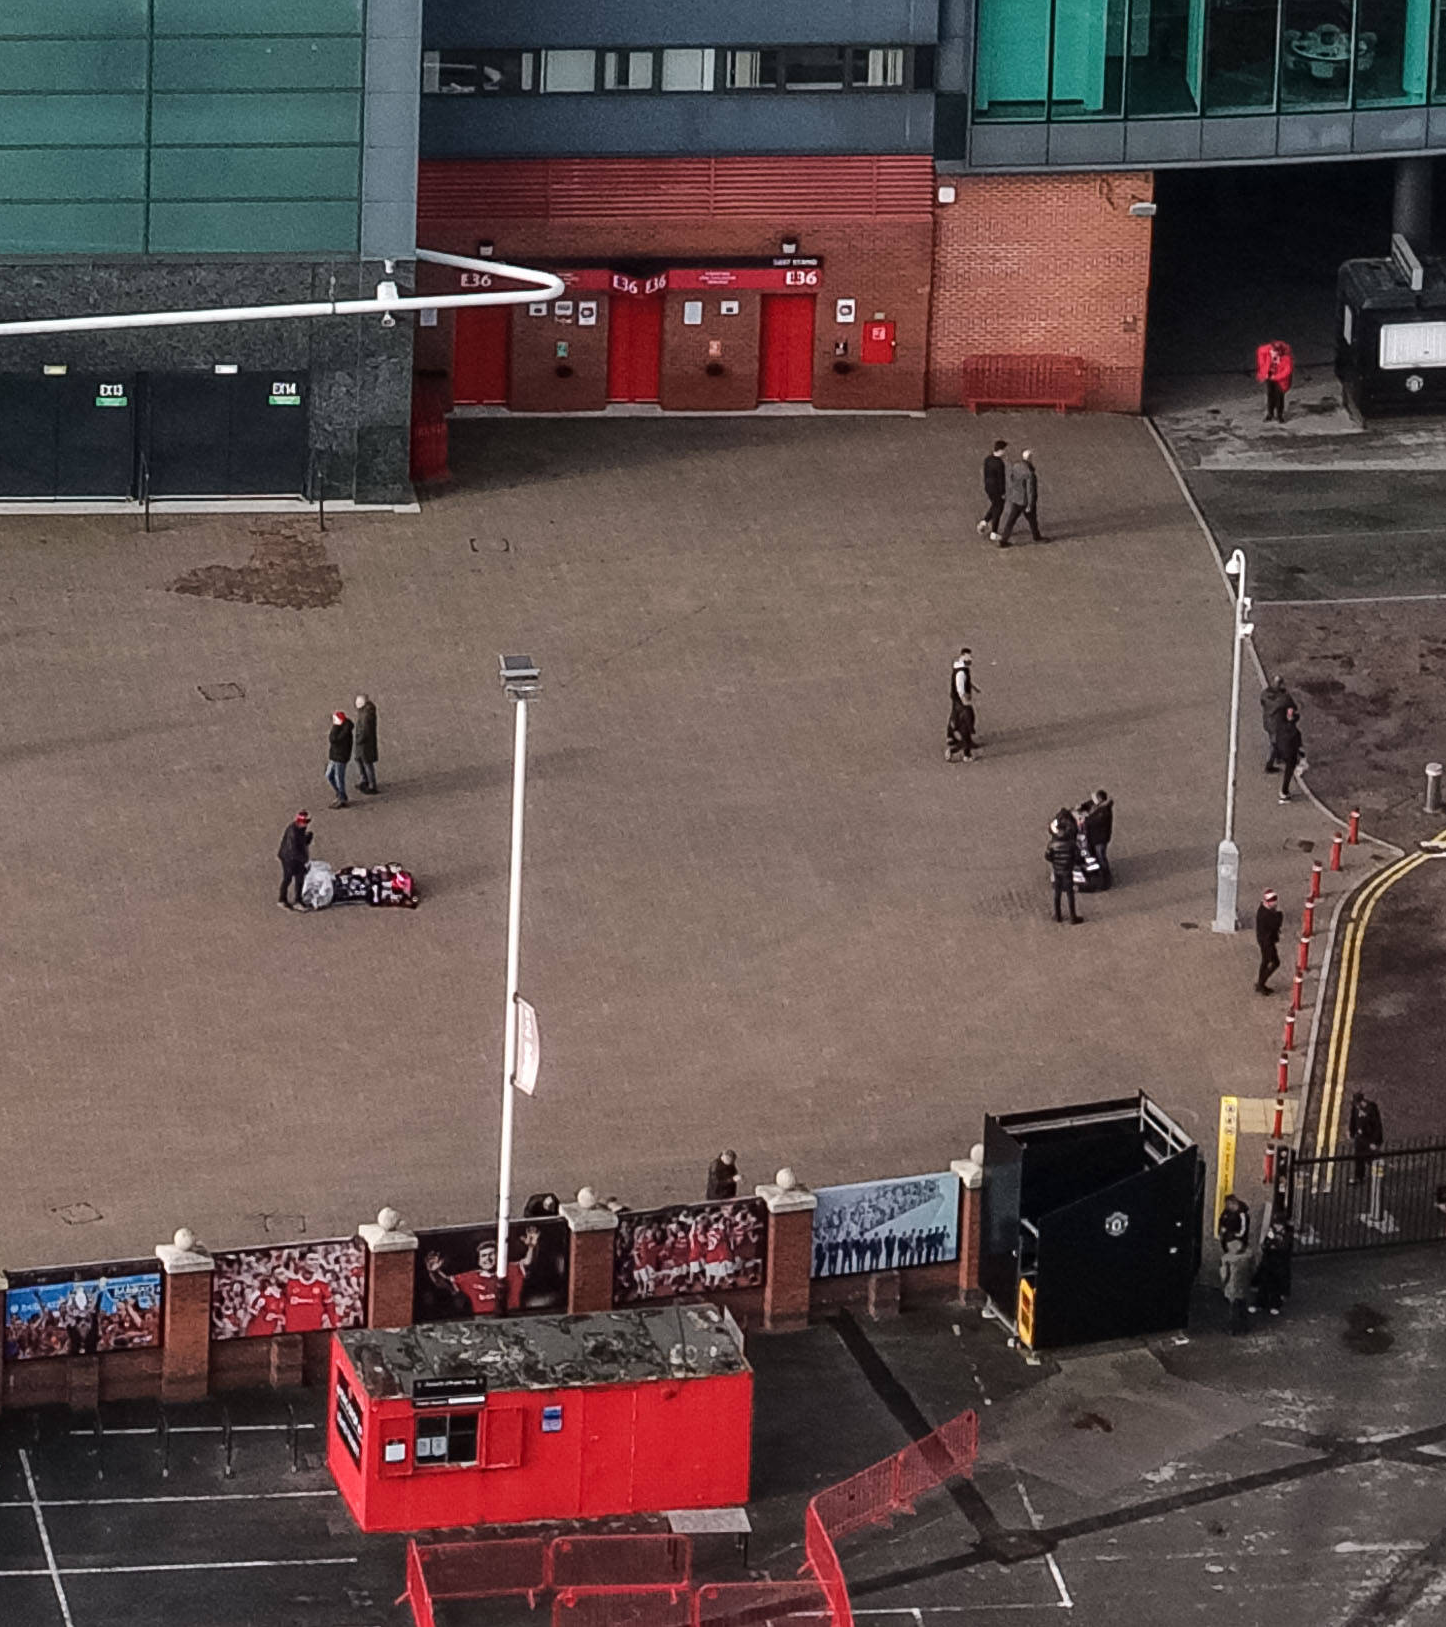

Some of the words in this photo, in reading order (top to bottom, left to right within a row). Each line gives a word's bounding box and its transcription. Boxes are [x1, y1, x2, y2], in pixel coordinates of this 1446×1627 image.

[460, 273, 493, 288] E36
[613, 274, 639, 295] E36
[644, 273, 667, 294] E36
[785, 270, 818, 286] E36
